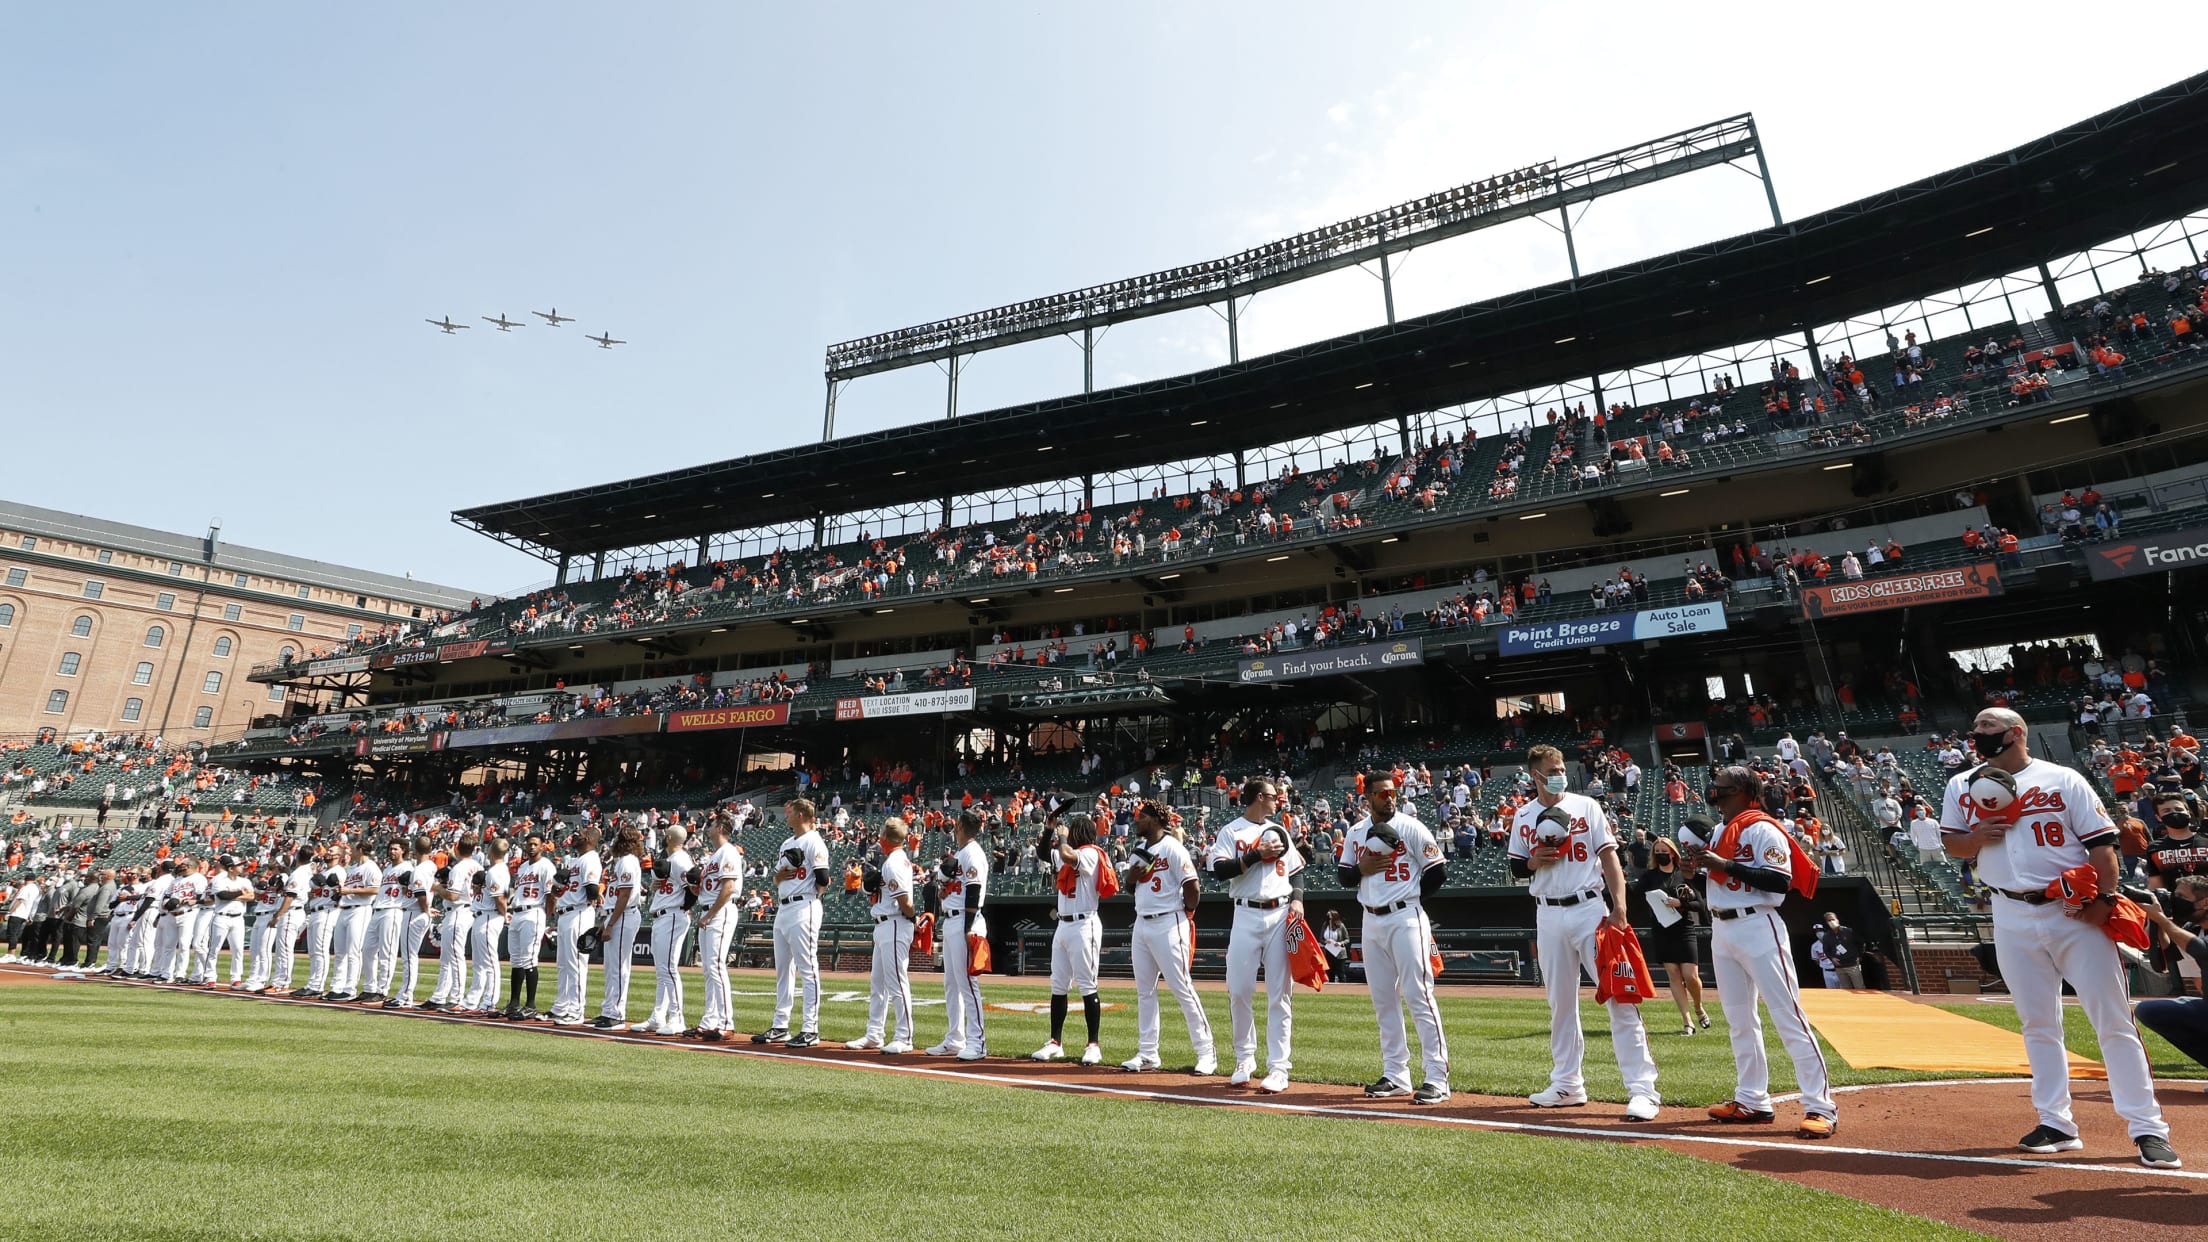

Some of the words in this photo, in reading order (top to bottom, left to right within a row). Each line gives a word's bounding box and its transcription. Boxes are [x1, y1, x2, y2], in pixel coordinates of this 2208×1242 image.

[1830, 584, 1869, 603] KIDS
[1870, 575, 1923, 598] CHEER
[1923, 570, 1965, 590] FREE
[1848, 602, 1868, 611] YOUR
[1896, 595, 1913, 604] AND
[1914, 592, 1941, 601] UNDER
[1942, 590, 1958, 598] FOR
[1649, 611, 1679, 622] Auto
[1682, 606, 1711, 618] Loan
[1508, 626, 1552, 643] Point
[1559, 619, 1621, 637] Breeze
[1667, 620, 1697, 634] Sale
[1533, 638, 1564, 649] Credit
[1566, 634, 1596, 645] Union
[1282, 661, 1307, 675] Find
[1310, 662, 1334, 676] your
[1336, 653, 1372, 668] beach.
[1381, 650, 1417, 665] Corona
[1241, 668, 1274, 681] Corona
[838, 699, 857, 710] NEED
[863, 698, 878, 708] TEXT
[879, 695, 910, 706] LOCATION
[914, 694, 969, 708] 410-873-9900
[837, 708, 860, 720] HELP?
[867, 706, 881, 716] AND
[882, 704, 900, 714] ISSUE
[901, 703, 910, 713] TO
[681, 712, 726, 728] WELLS
[729, 708, 776, 724] FARGO
[373, 736, 398, 745] University
[405, 734, 428, 744] Maryland
[371, 744, 389, 753] Medical
[390, 743, 408, 752] Center
[2030, 821, 2065, 847] 18
[1567, 841, 1588, 863] 16
[2157, 847, 2208, 860] ORIOLE
[1275, 860, 1286, 877] 6
[1384, 862, 1411, 881] 25
[705, 878, 721, 892] 67
[1150, 876, 1162, 893] 3
[522, 887, 540, 899] 55
